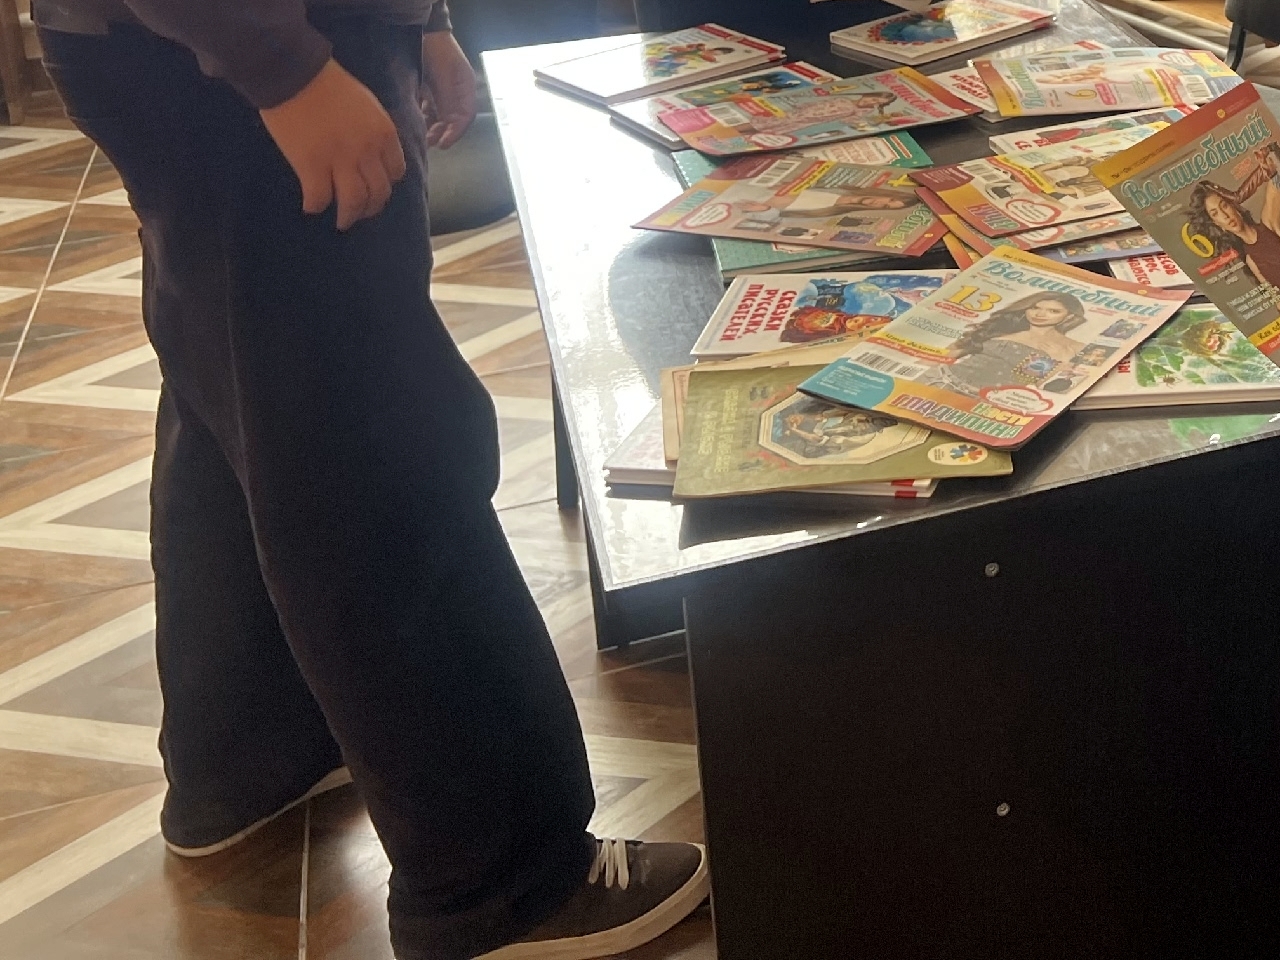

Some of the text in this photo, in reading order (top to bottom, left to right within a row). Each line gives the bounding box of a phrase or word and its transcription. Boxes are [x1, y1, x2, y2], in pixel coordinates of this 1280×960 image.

[1121, 110, 1271, 209] Волшебный
[1181, 223, 1215, 258] 6
[944, 285, 1002, 312] 13
[980, 258, 1167, 317] Волшебный
[743, 289, 780, 335] РУССКИХ
[763, 290, 797, 331] СКАЗКИ
